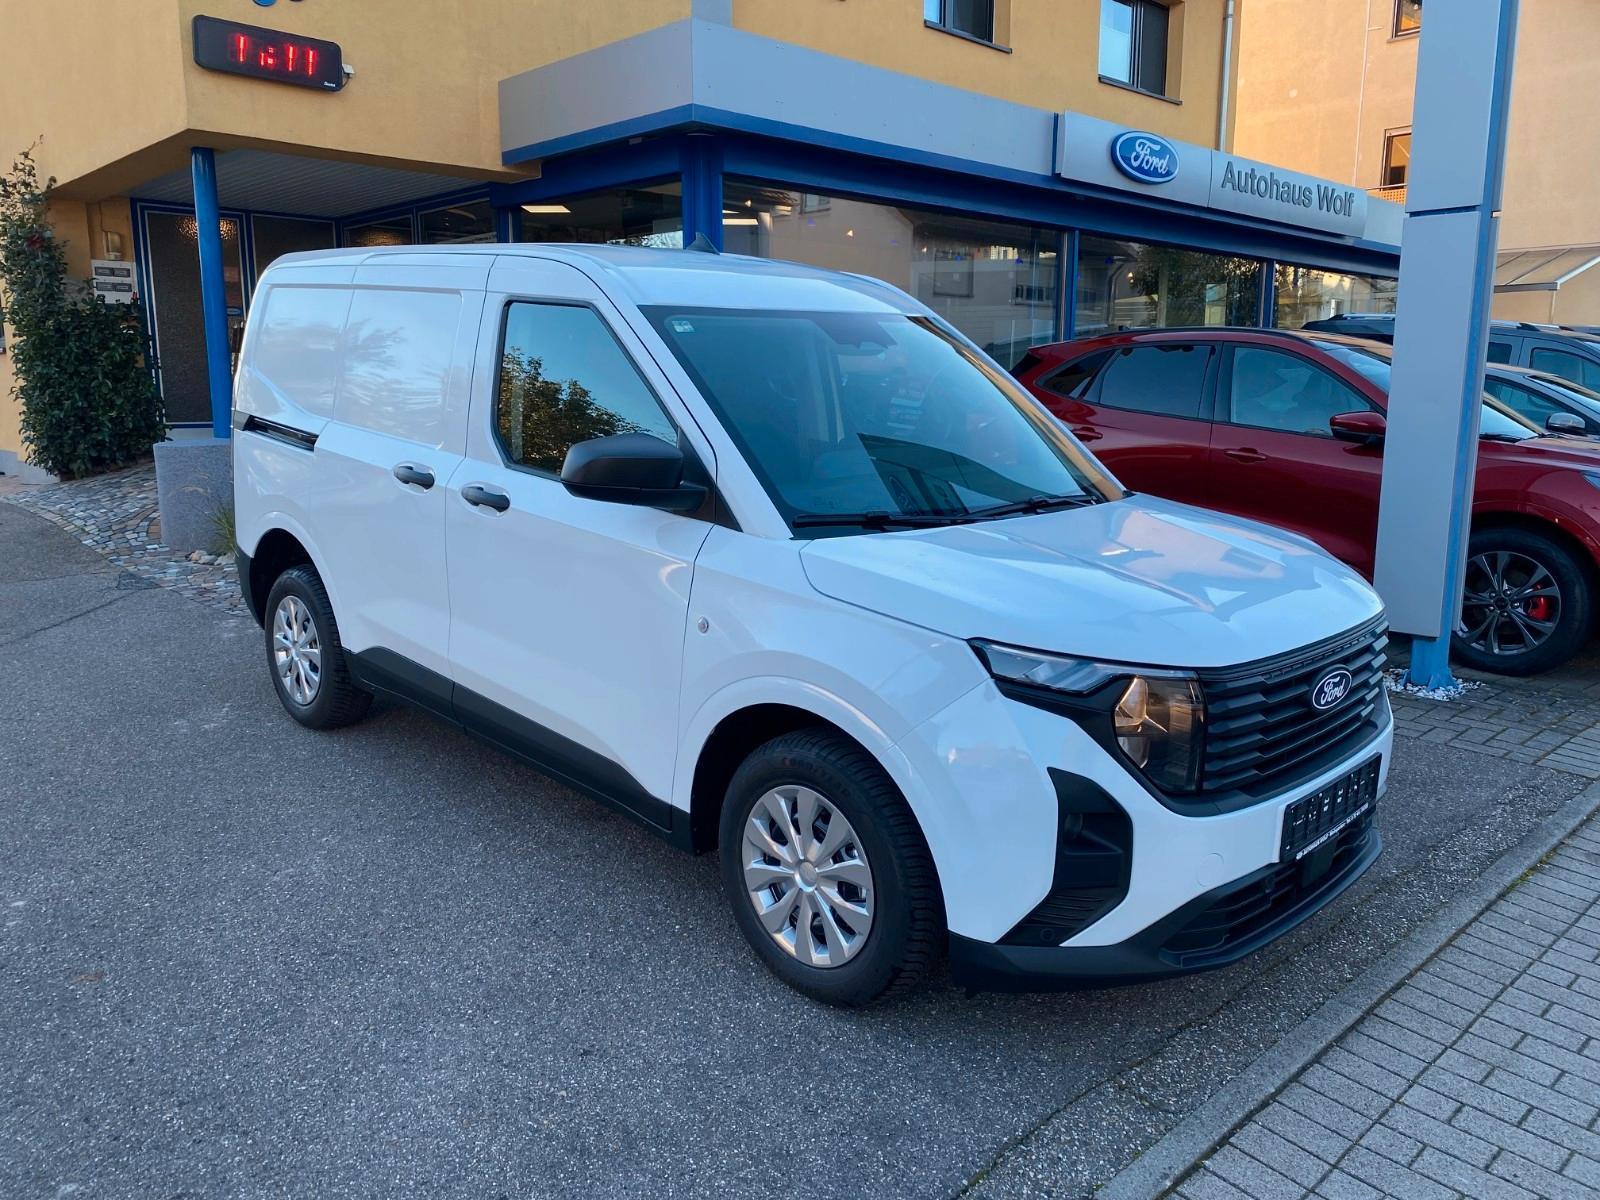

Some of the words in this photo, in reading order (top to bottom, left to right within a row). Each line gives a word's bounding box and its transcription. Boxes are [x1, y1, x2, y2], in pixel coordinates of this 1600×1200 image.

[1130, 138, 1169, 174] Ford
[1221, 161, 1313, 209] Autohaus
[1316, 183, 1355, 217] Wolf
[1320, 676, 1346, 705] Ford
